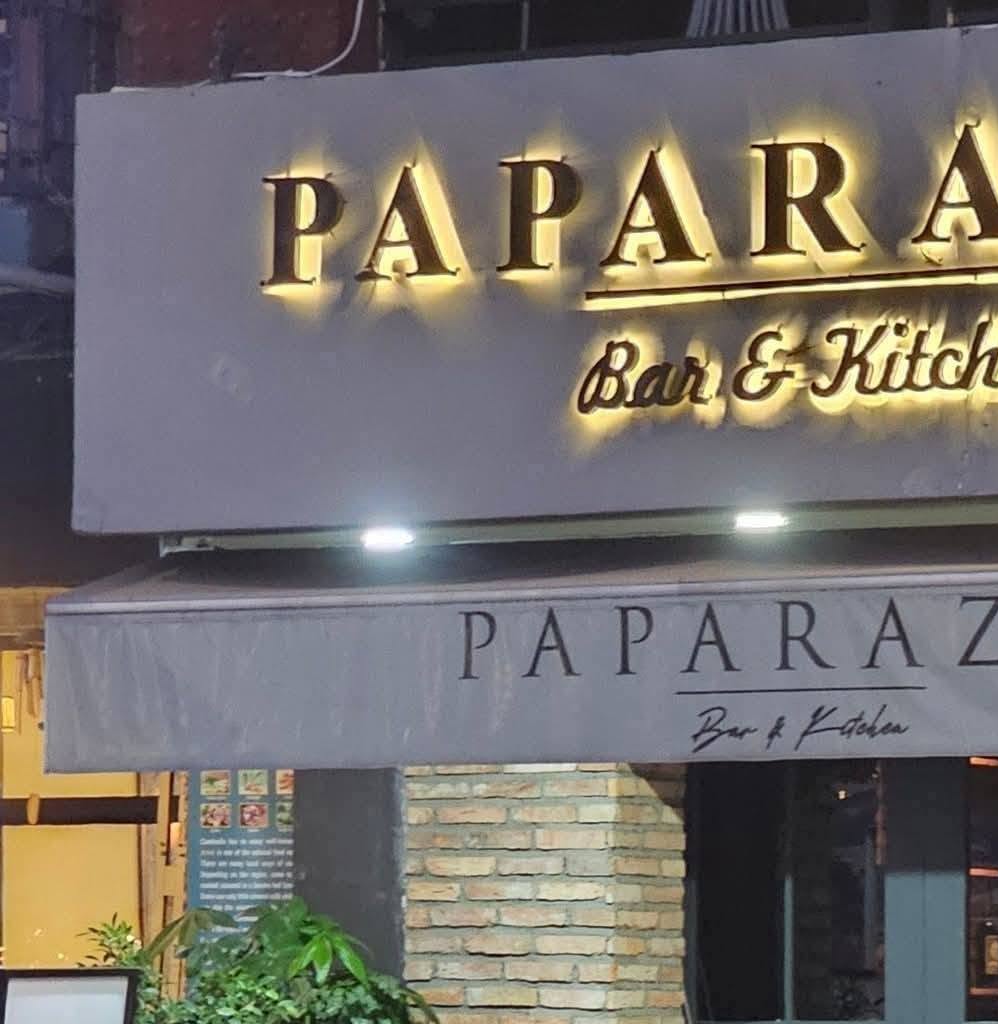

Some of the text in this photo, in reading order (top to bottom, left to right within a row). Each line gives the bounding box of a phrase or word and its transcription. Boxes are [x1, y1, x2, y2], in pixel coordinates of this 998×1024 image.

[577, 339, 719, 414] Bar
[732, 330, 797, 400] &
[691, 706, 757, 753] Bar
